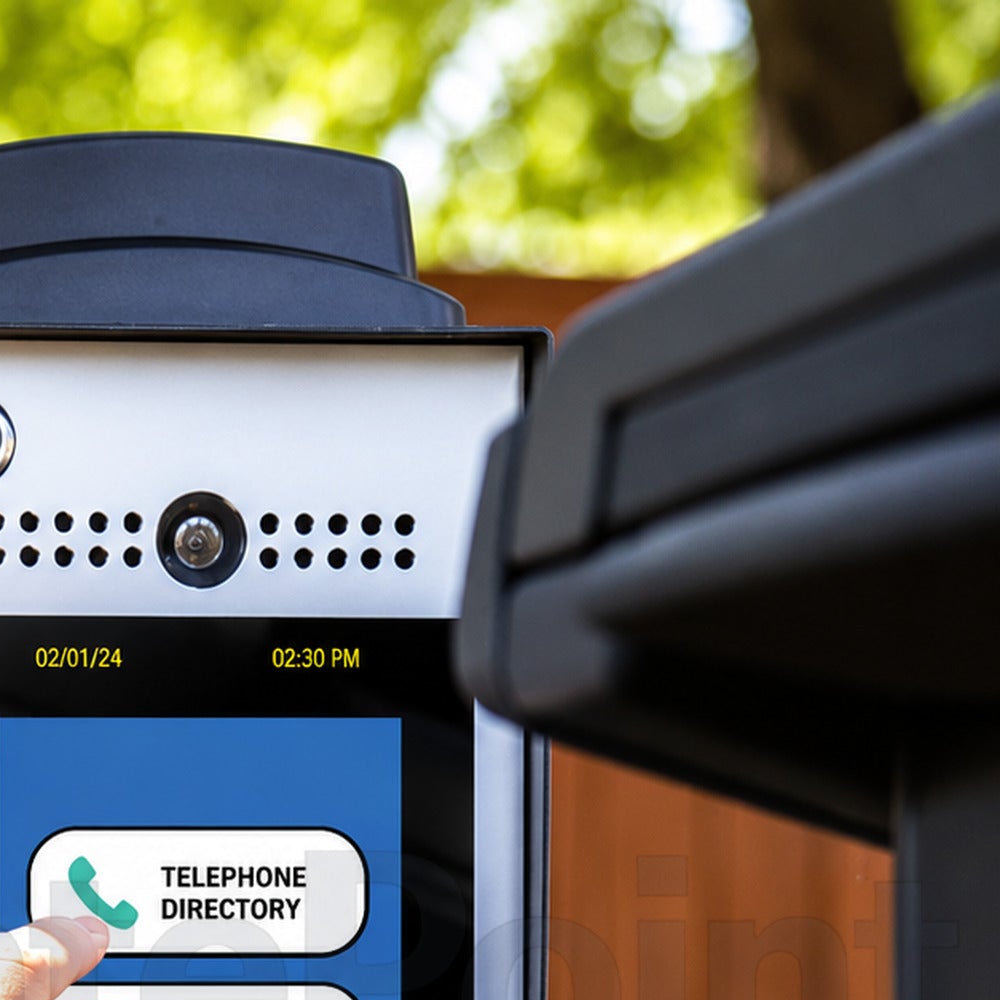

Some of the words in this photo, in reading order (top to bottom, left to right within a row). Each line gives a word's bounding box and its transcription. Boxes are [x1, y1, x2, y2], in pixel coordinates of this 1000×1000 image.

[35, 647, 123, 669] 02/01/24
[271, 647, 325, 669] 02:30
[331, 648, 361, 668] PM
[160, 866, 307, 888] TELEPHONE
[160, 897, 301, 920] DIRECTORY
